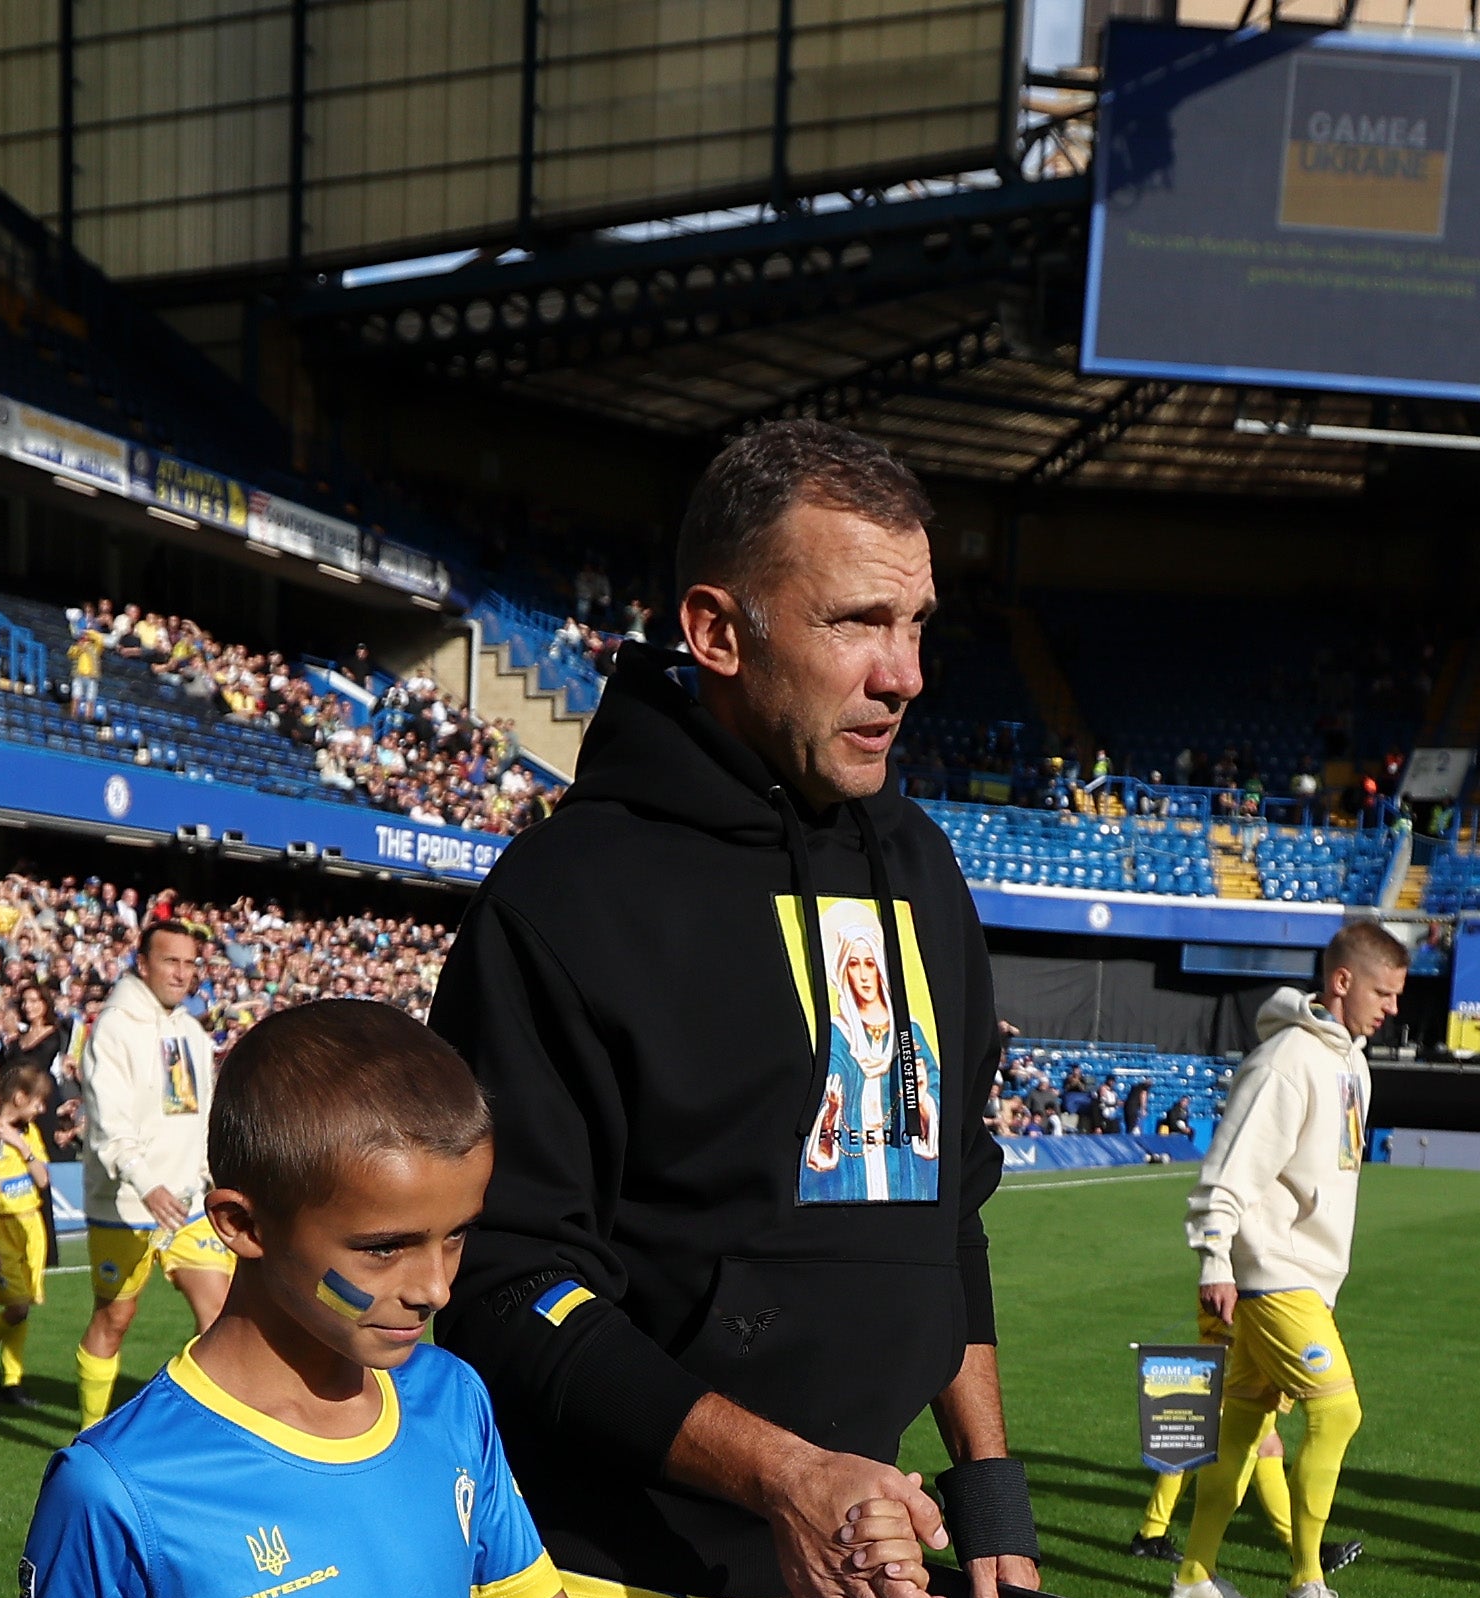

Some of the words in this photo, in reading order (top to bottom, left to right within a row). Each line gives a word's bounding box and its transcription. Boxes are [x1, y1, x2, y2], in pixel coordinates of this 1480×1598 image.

[1307, 110, 1428, 147] GAME4
[1300, 144, 1431, 181] UKRAINE
[375, 825, 415, 862] THE
[417, 832, 474, 872] PRIDE
[474, 844, 494, 865] OF
[899, 1030, 912, 1063] RULES
[903, 1063, 914, 1077] OF
[905, 1077, 917, 1110] FAITH
[1150, 1364, 1192, 1375] GAME4
